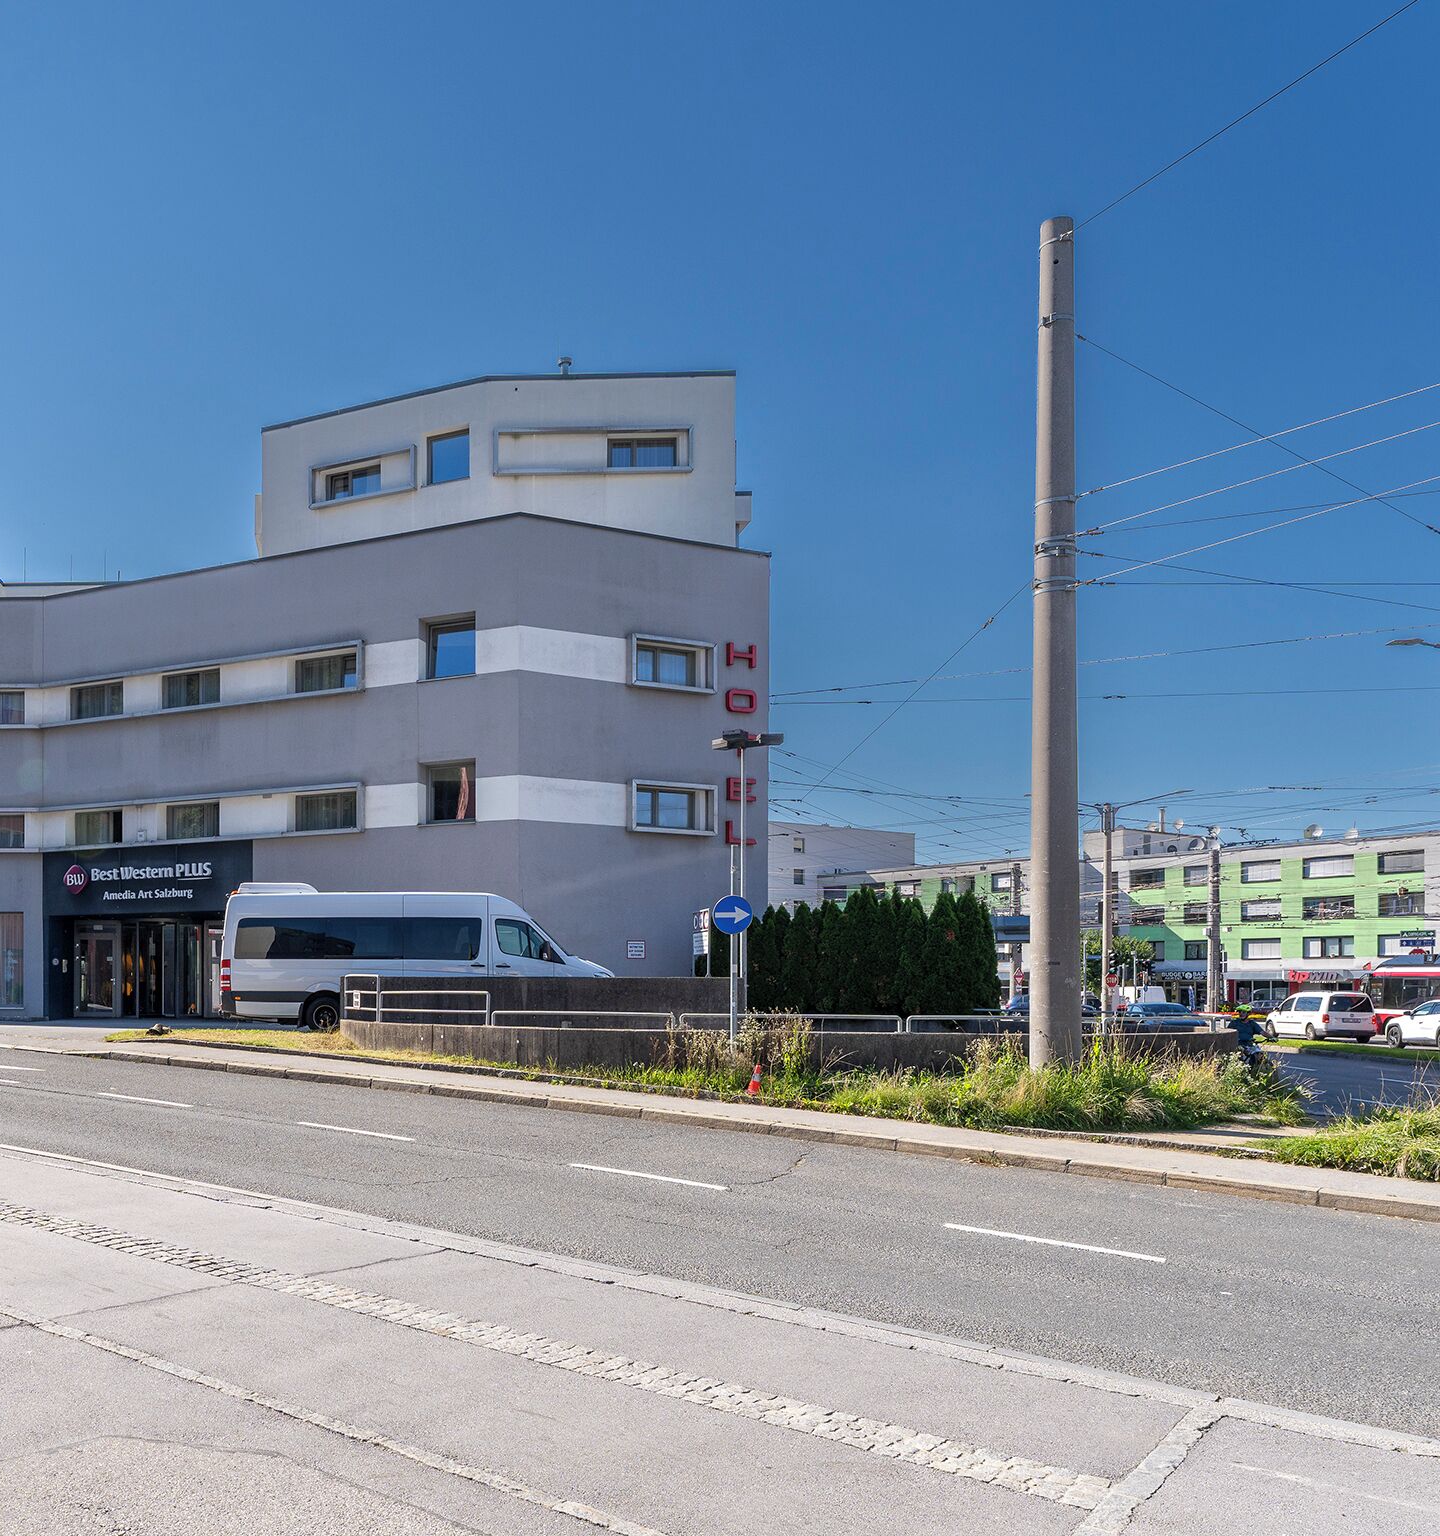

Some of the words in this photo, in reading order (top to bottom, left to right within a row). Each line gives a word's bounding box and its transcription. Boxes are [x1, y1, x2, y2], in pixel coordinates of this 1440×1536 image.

[725, 641, 757, 845] HOEL
[90, 868, 119, 882] Best
[120, 866, 174, 880] Western
[175, 862, 212, 877] PLUS
[66, 873, 85, 886] BW
[103, 889, 136, 901] Amedia
[138, 889, 153, 899] Art
[155, 887, 193, 899] Salzburg
[1106, 976, 1118, 985] STOP
